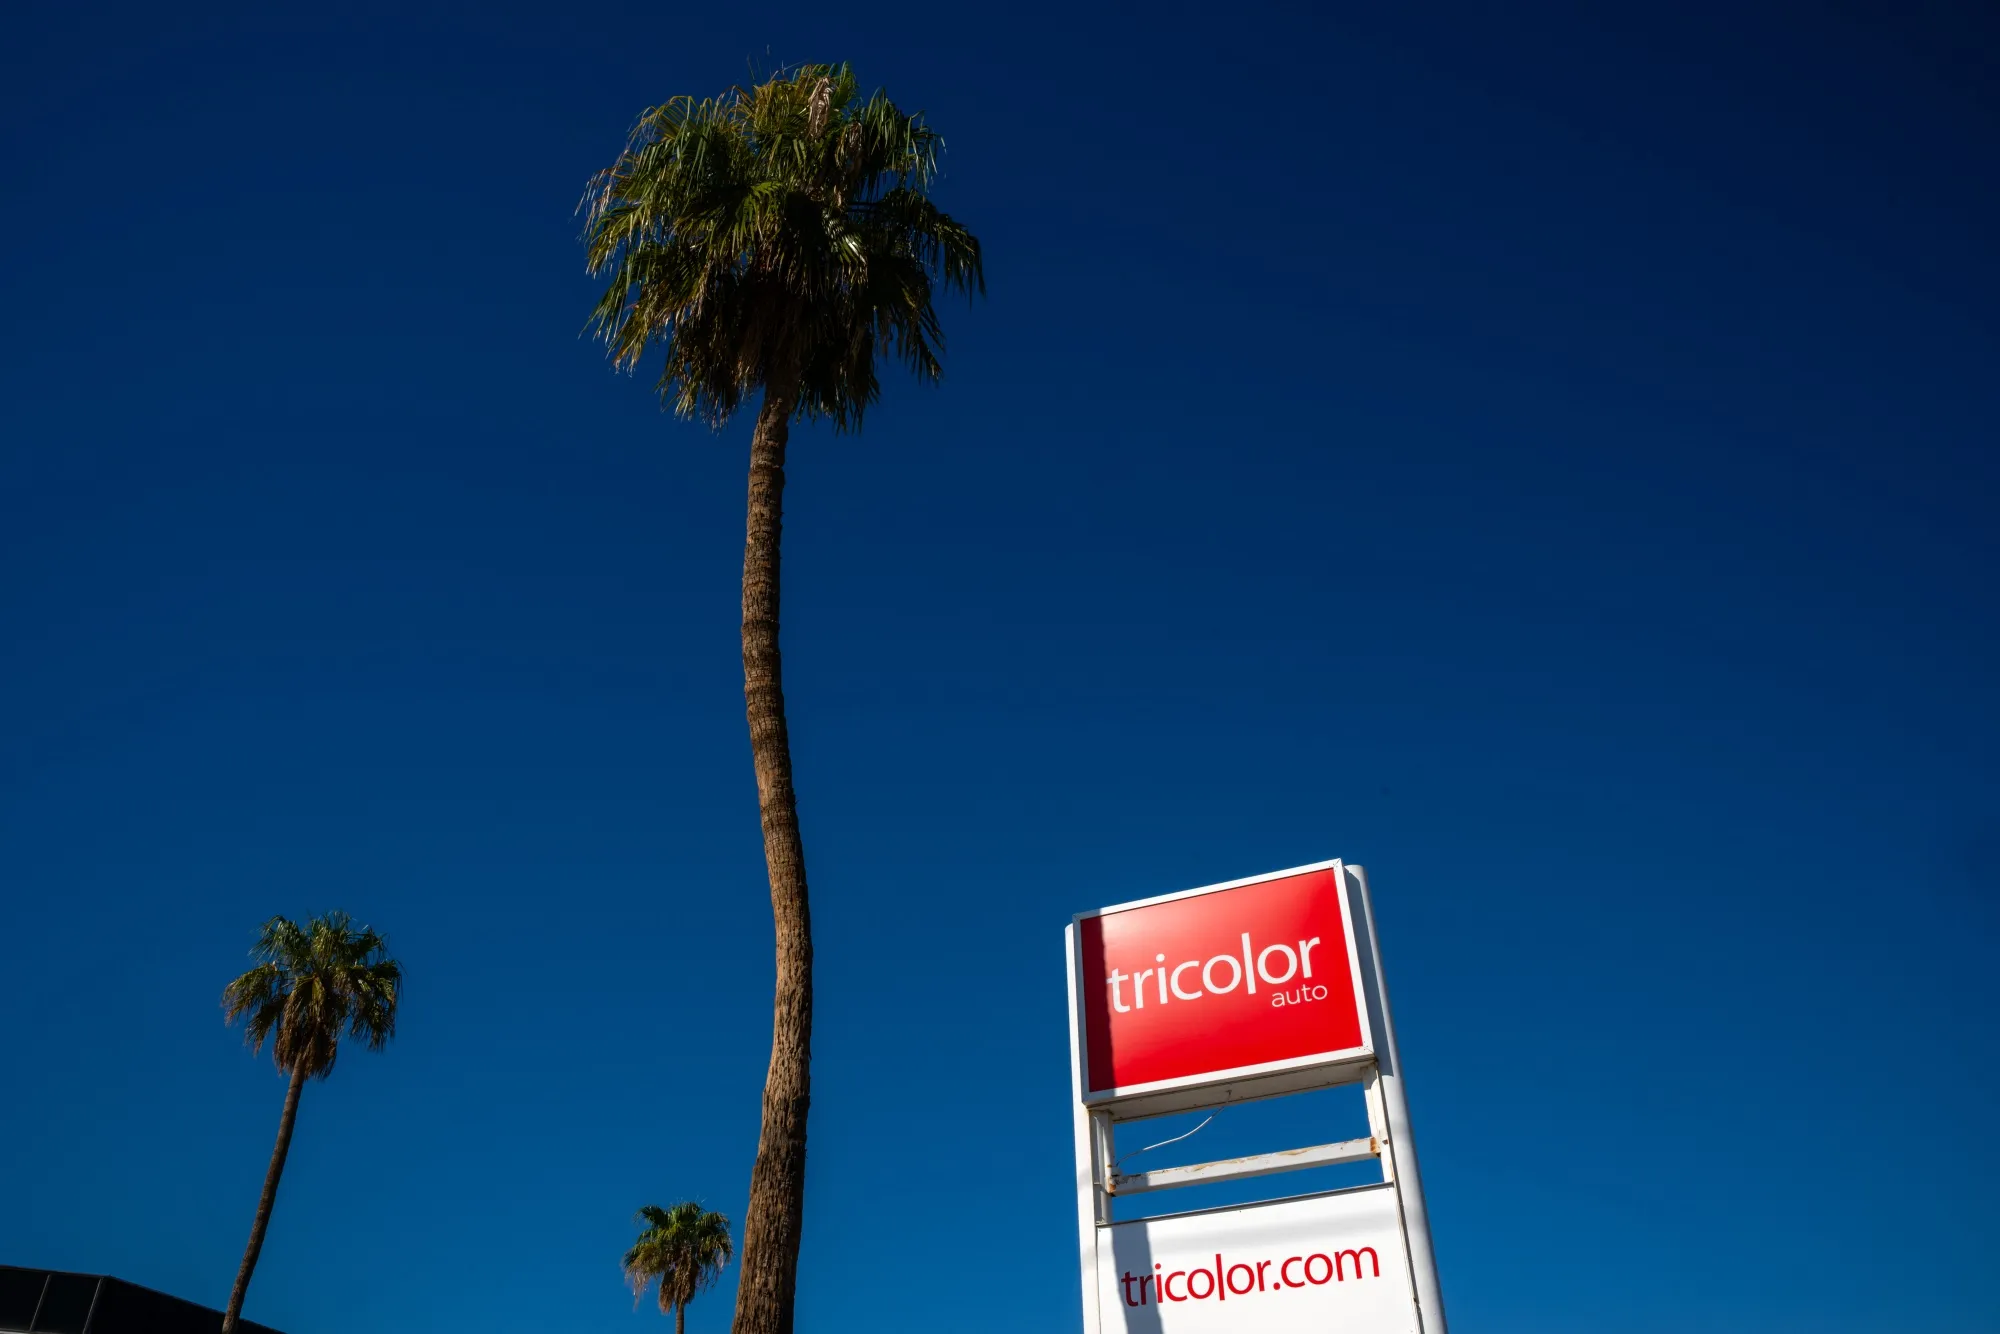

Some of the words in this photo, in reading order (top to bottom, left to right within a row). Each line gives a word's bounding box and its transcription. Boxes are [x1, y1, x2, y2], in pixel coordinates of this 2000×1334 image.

[1106, 932, 1320, 1013] tricolor
[1271, 983, 1328, 1008] auto
[1121, 1246, 1380, 1307] tricolor.com
